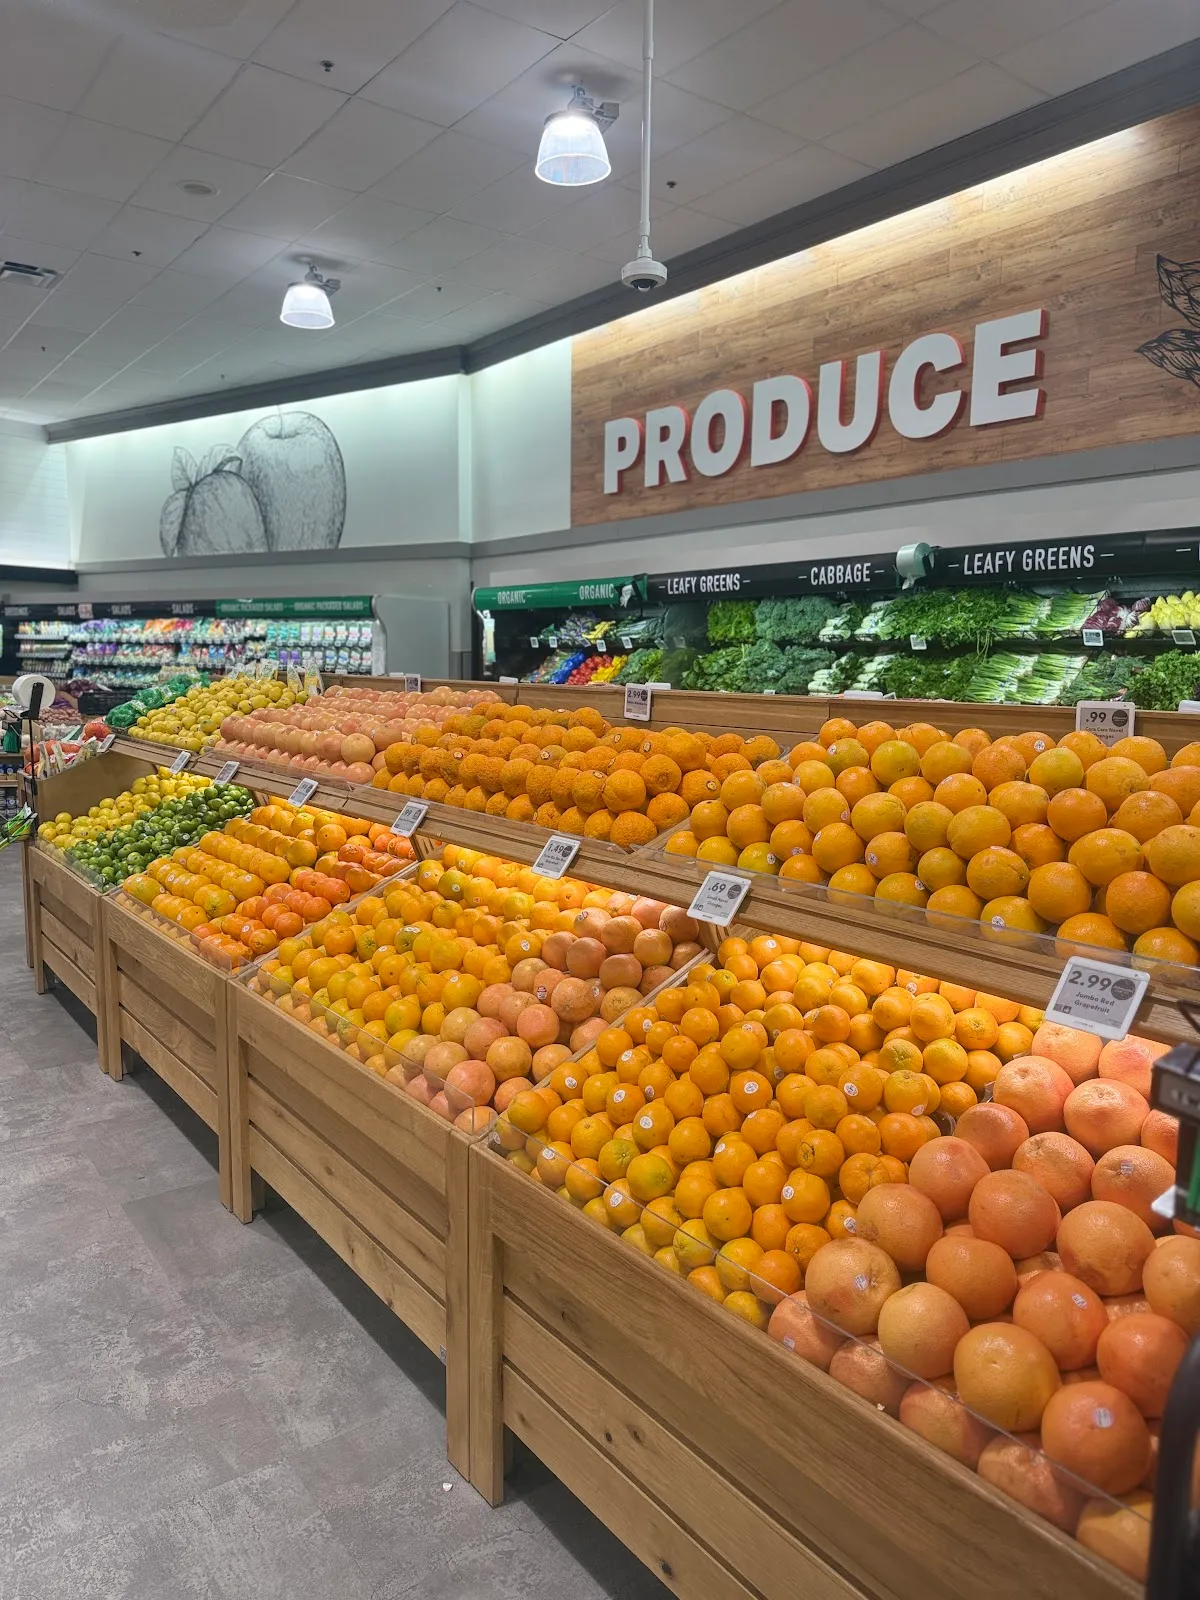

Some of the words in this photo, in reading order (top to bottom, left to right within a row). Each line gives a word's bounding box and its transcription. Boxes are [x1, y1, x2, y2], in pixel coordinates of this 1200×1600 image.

[603, 308, 1044, 494] PRODUCE
[963, 550, 1017, 575] LEAFY
[1022, 544, 1095, 572] GREENS
[810, 562, 871, 585] CABBAGE
[579, 583, 614, 600] ORGANIC
[667, 576, 697, 595] LEAFY
[699, 573, 741, 593] GREENS
[497, 590, 526, 605] ORGANIC
[1086, 711, 1106, 722] .99
[548, 843, 564, 853] 1.49
[708, 882, 726, 892] .69
[1068, 971, 1112, 991] 2.99
[1074, 999, 1110, 1013] Grapefruit
[1076, 991, 1098, 1002] Jumbo
[1100, 997, 1115, 1006] Red
